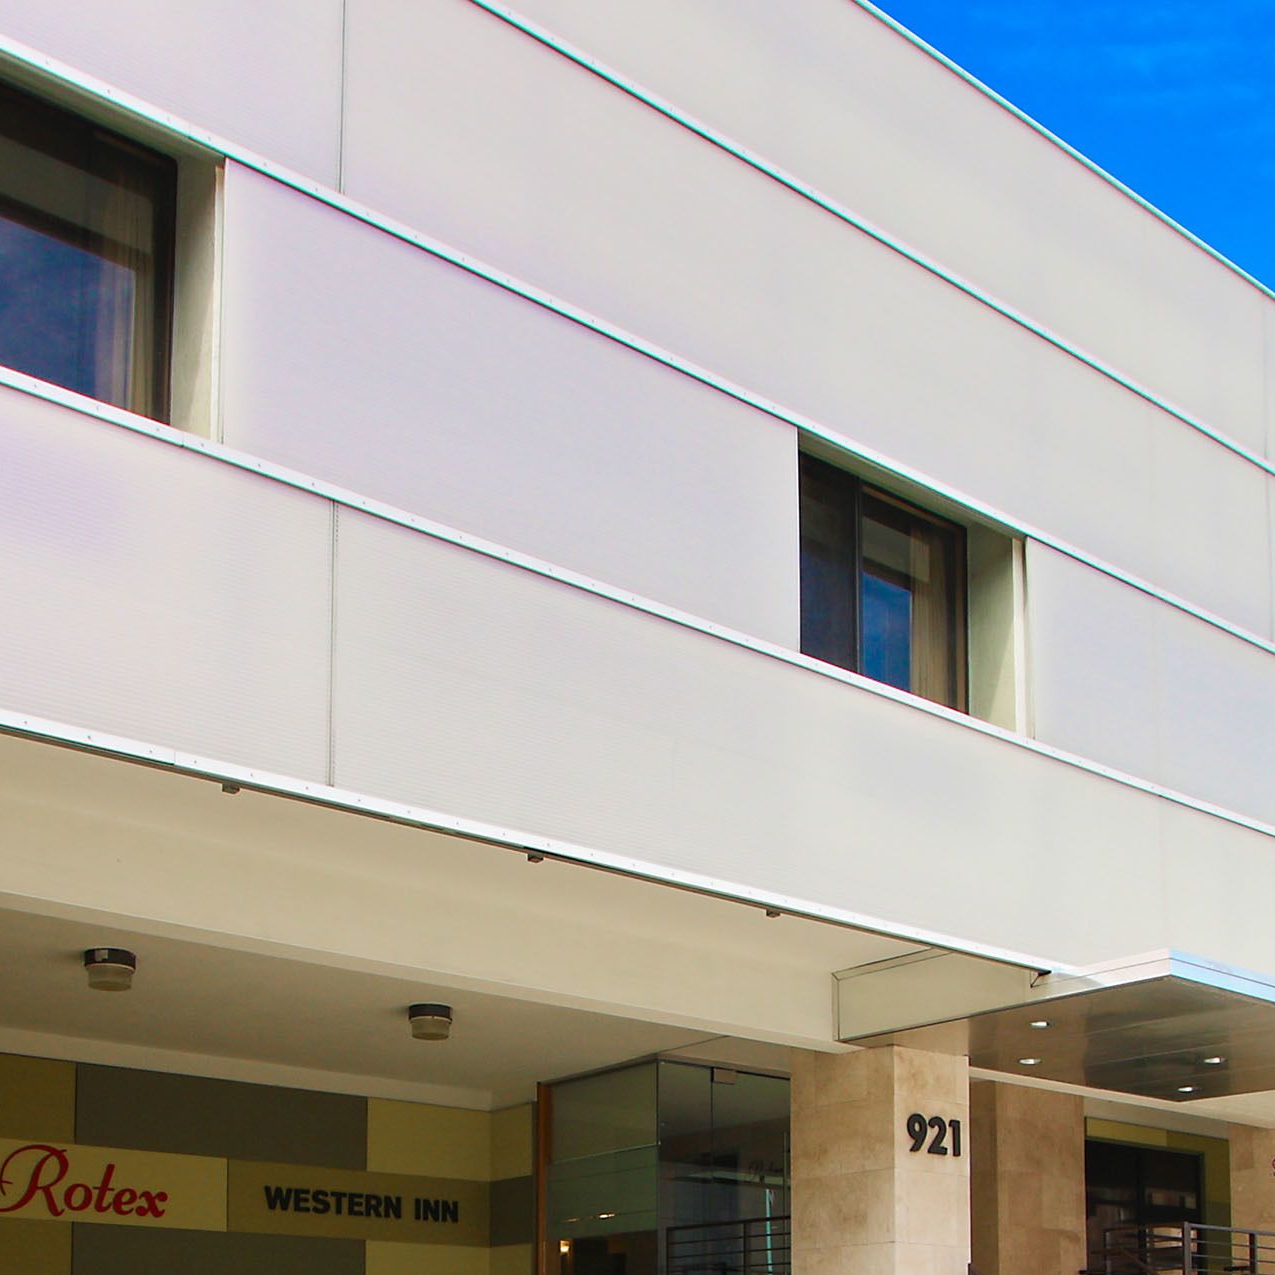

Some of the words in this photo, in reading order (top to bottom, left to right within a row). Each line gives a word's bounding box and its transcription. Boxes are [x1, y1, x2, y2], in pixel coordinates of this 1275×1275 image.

[906, 1113, 962, 1158] 921
[263, 1185, 402, 1220] WESTERN
[414, 1197, 460, 1223] INN
